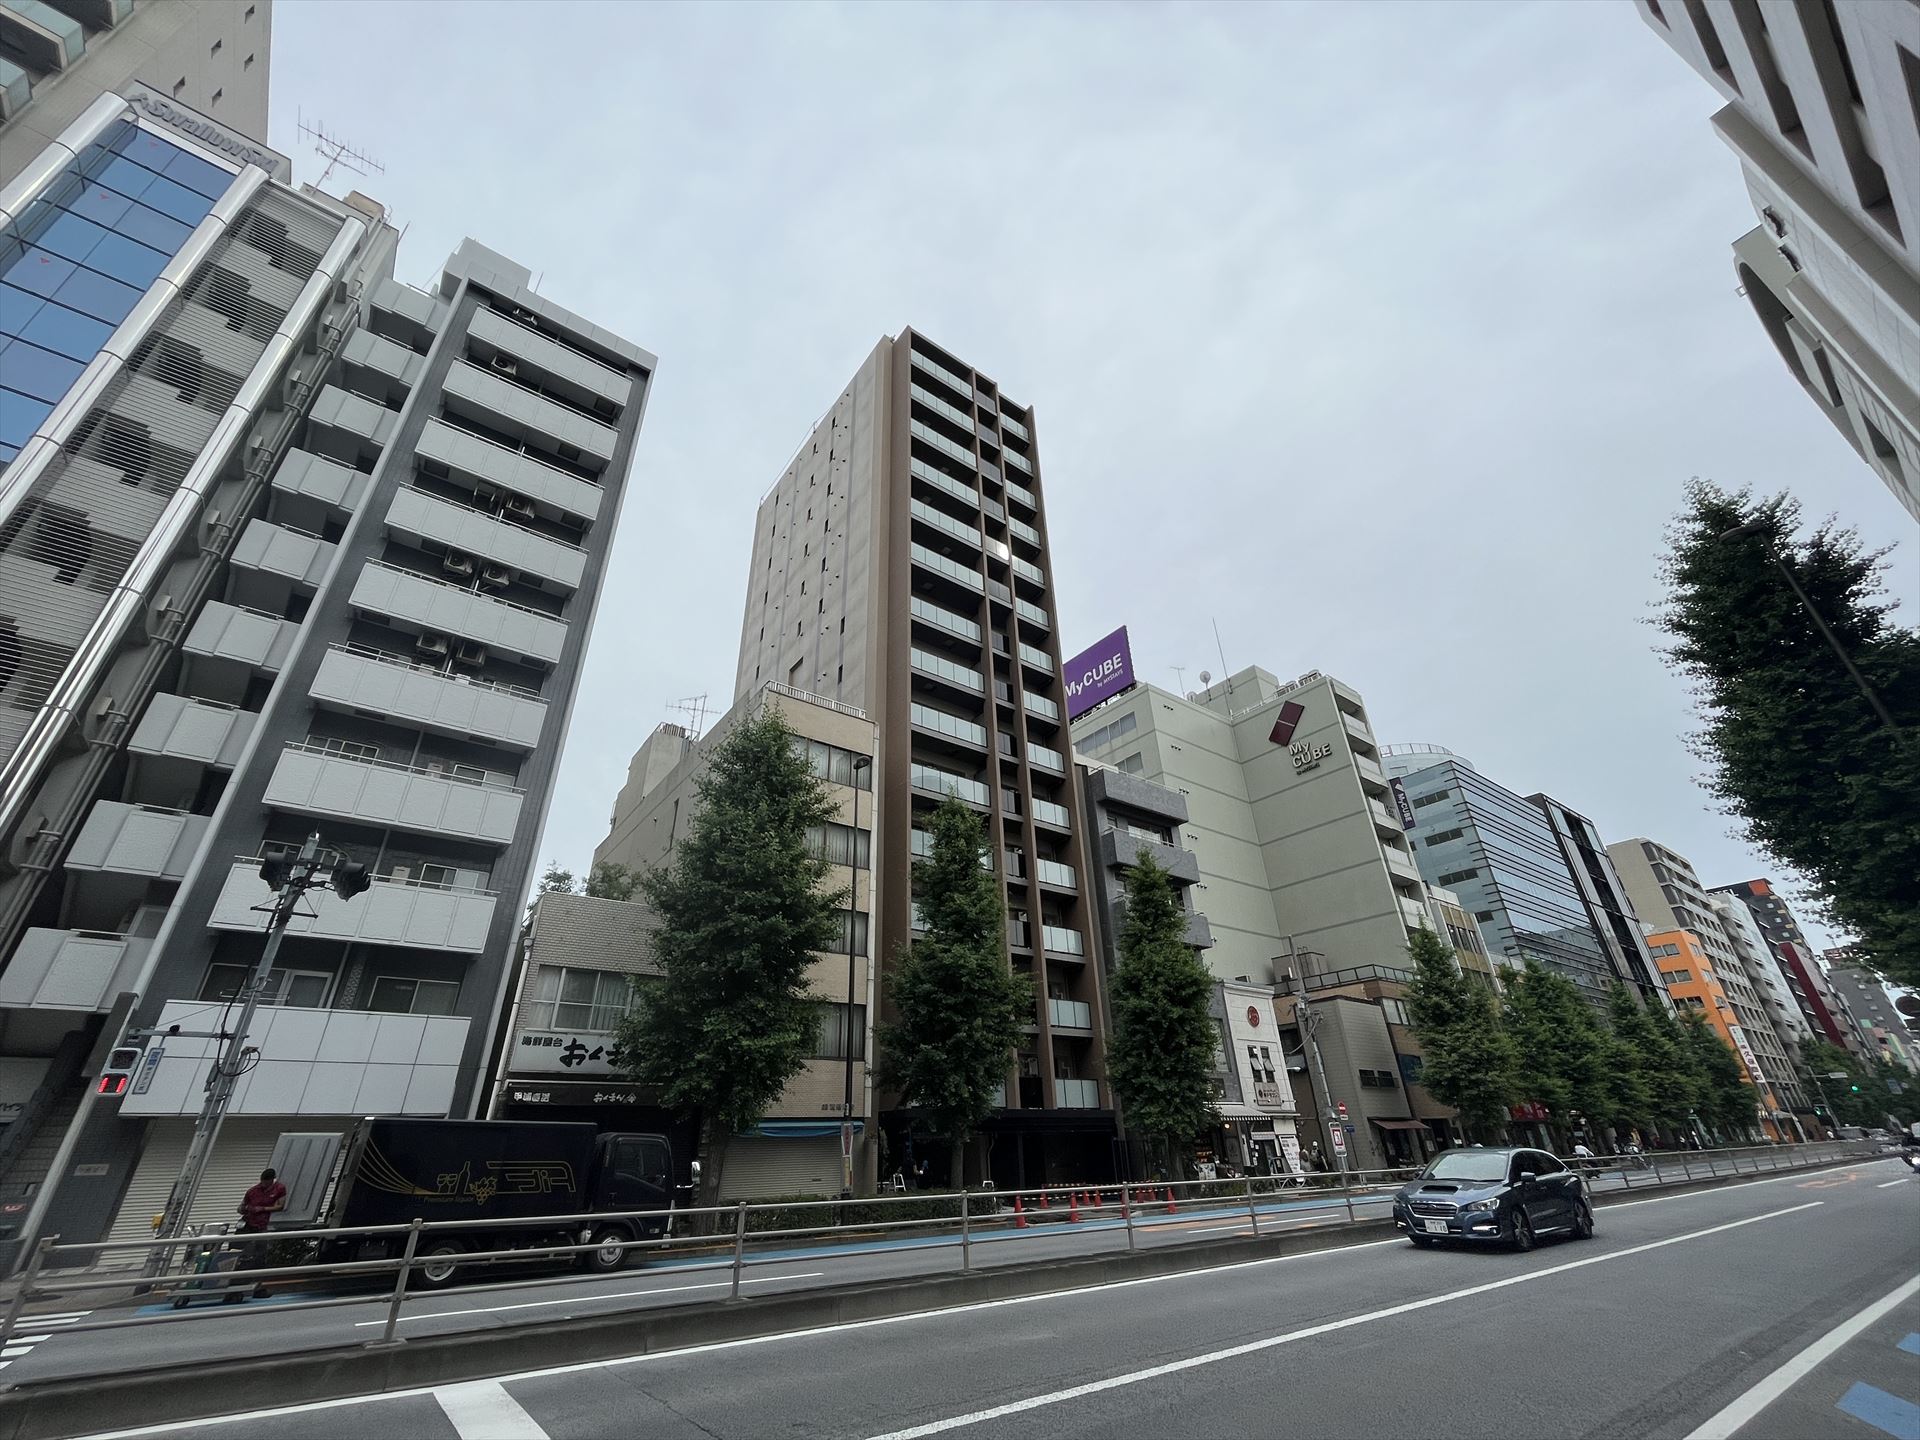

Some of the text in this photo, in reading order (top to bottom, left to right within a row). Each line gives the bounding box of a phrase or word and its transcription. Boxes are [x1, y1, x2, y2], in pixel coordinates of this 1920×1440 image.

[1065, 653, 1122, 697] MyCUBE
[1292, 743, 1332, 768] CUBE
[521, 1035, 563, 1047] 海鮮屋台
